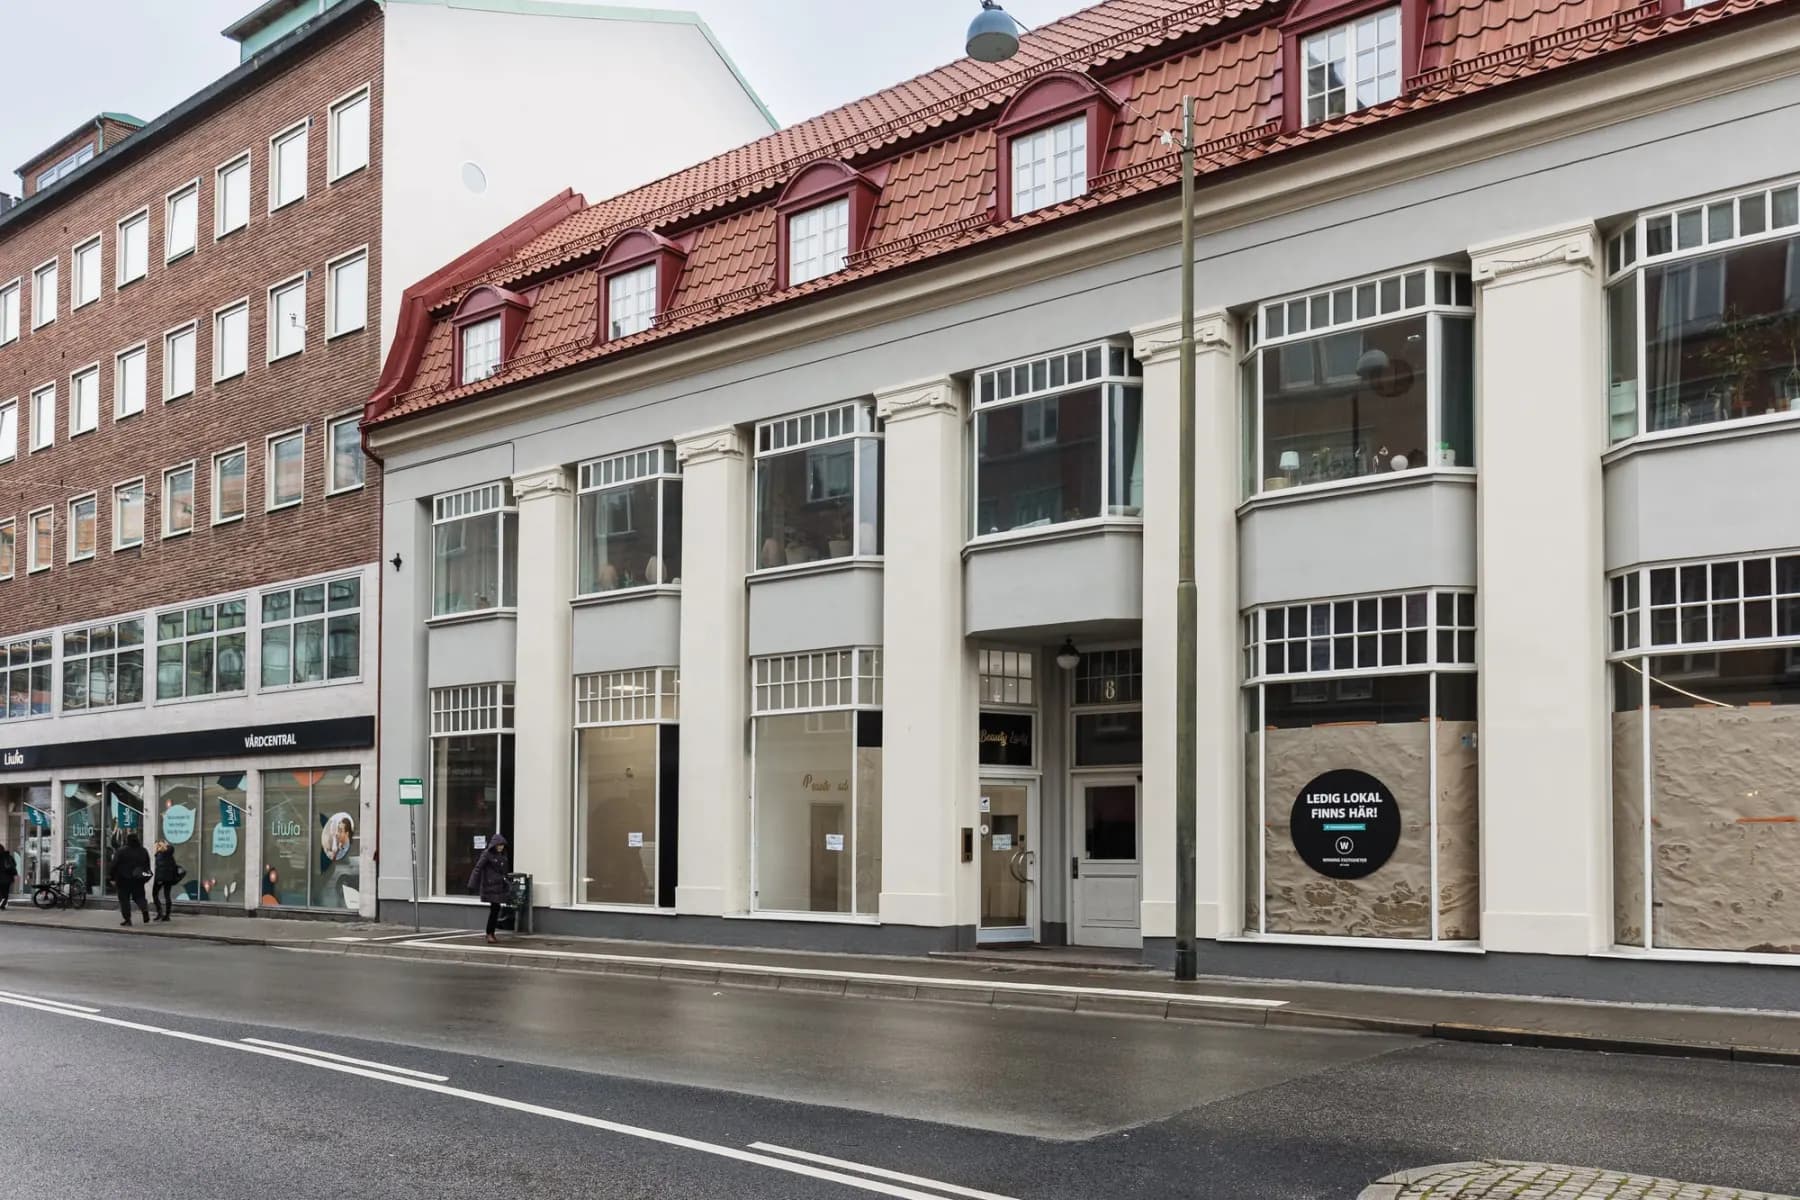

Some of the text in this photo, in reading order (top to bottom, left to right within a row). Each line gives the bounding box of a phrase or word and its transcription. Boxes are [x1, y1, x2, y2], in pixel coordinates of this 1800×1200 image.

[244, 732, 297, 749] VÅRDCENTRAL
[1306, 792, 1383, 804] LEDIG LOKAL
[1311, 805, 1378, 819] FINNS HÄR!
[1339, 841, 1349, 850] W
